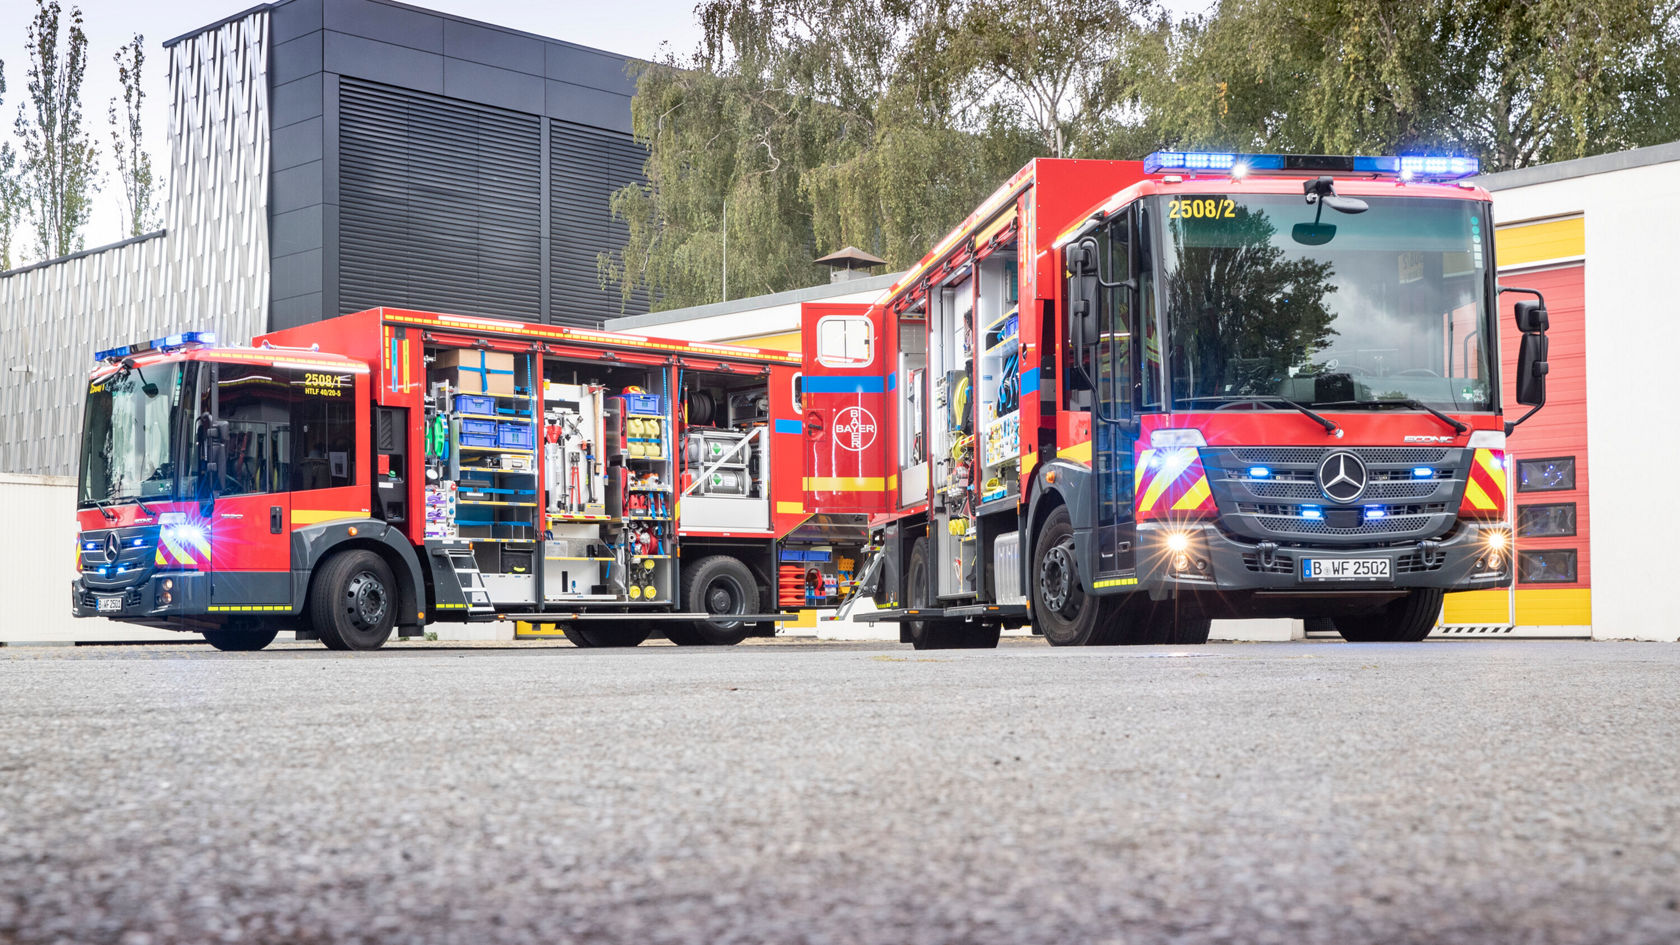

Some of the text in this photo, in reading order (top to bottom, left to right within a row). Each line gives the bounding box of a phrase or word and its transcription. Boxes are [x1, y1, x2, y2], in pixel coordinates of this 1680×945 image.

[1168, 199, 1236, 220] 2508/2
[304, 373, 341, 388] 2508/1
[305, 387, 320, 395] HTLF
[835, 425, 875, 433] BAYER
[850, 409, 861, 448] BAYER
[1404, 435, 1454, 443] ECONIC
[1313, 561, 1322, 575] B
[1332, 561, 1350, 575] WF
[1353, 561, 1388, 575] 2502
